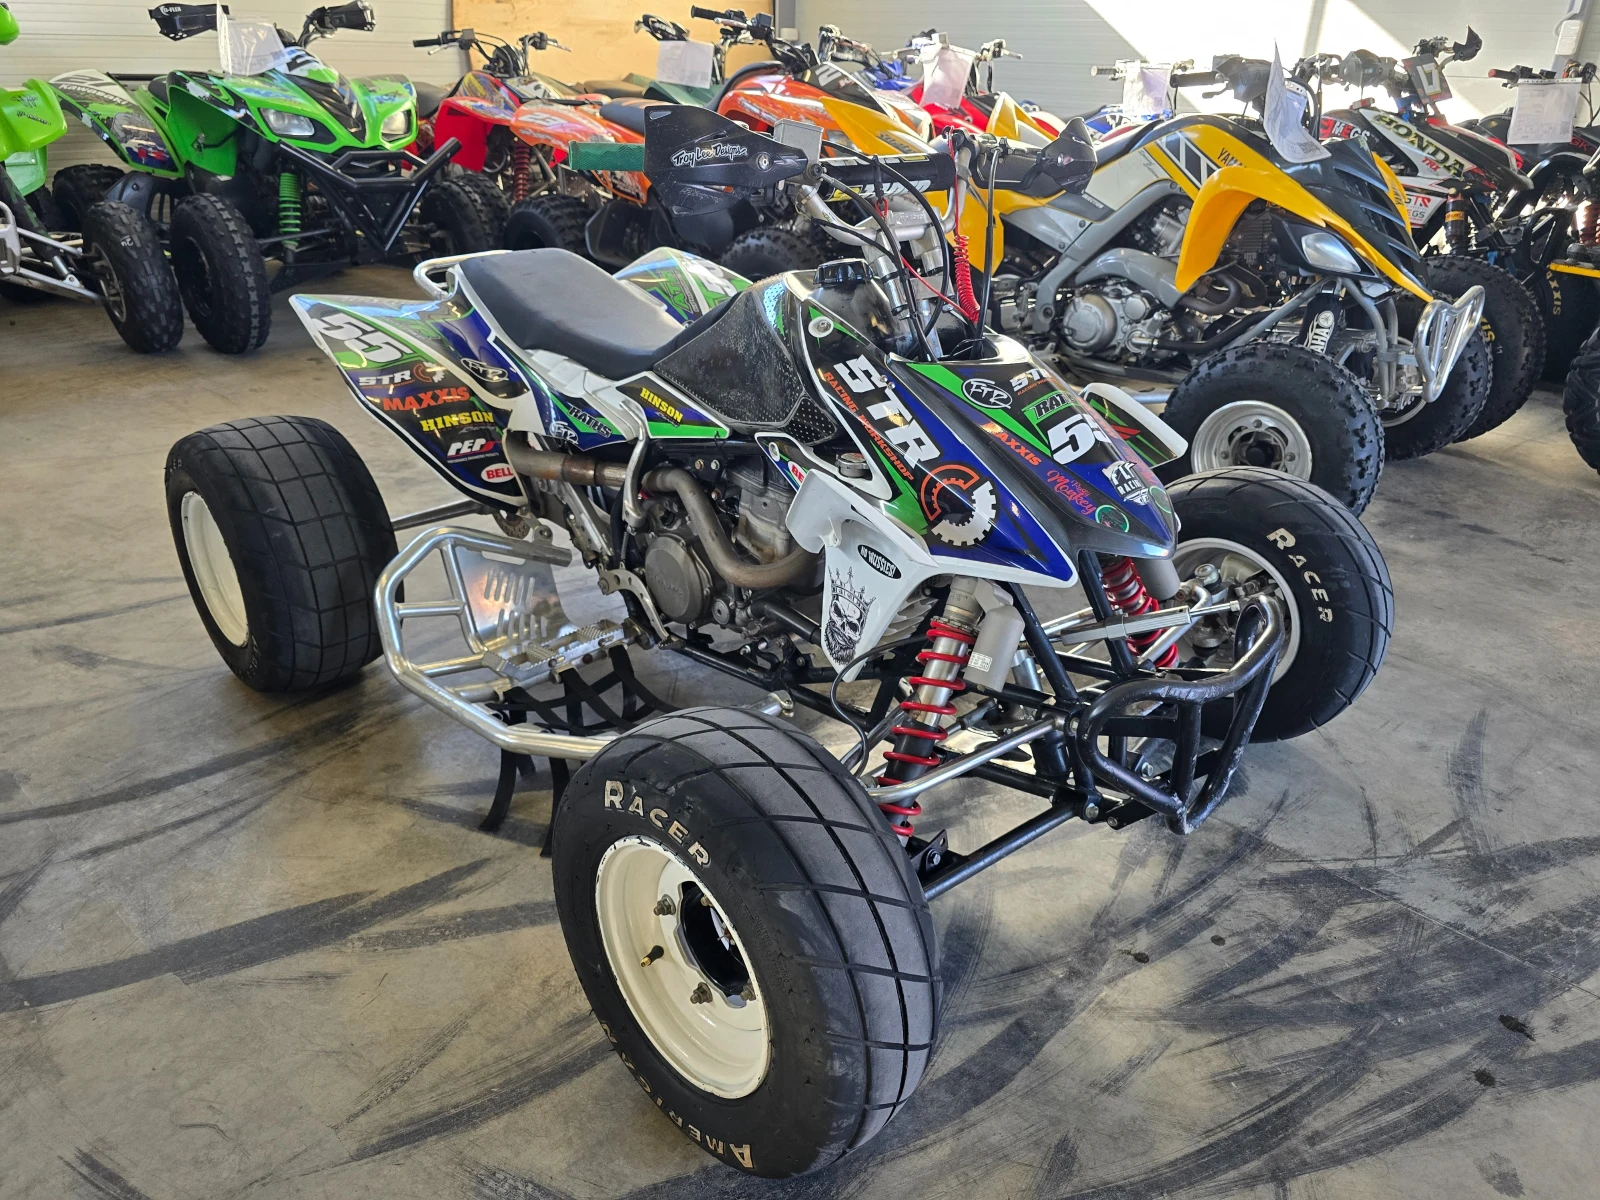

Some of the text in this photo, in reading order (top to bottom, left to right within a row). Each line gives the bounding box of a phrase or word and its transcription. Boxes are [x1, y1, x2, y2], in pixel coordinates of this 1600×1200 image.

[59, 84, 129, 105] Kawasaki
[670, 143, 748, 168] Troy Lee Designs
[1370, 113, 1466, 182] HONDA
[1421, 156, 1442, 172] TRX
[1545, 265, 1562, 316] AXXIS
[311, 313, 415, 363] 55
[359, 369, 411, 385] STR
[383, 386, 471, 411] MAXXIS
[640, 387, 684, 424] HINSON
[833, 354, 940, 469] STR
[420, 411, 494, 432] HINSON
[569, 404, 613, 439] RATHS
[824, 372, 914, 480] RACING WORKSHOP
[485, 467, 513, 480] BELL
[791, 465, 804, 483] BE
[1047, 470, 1097, 515] Monkey
[1266, 527, 1333, 623] RACER
[604, 779, 710, 867] RACER
